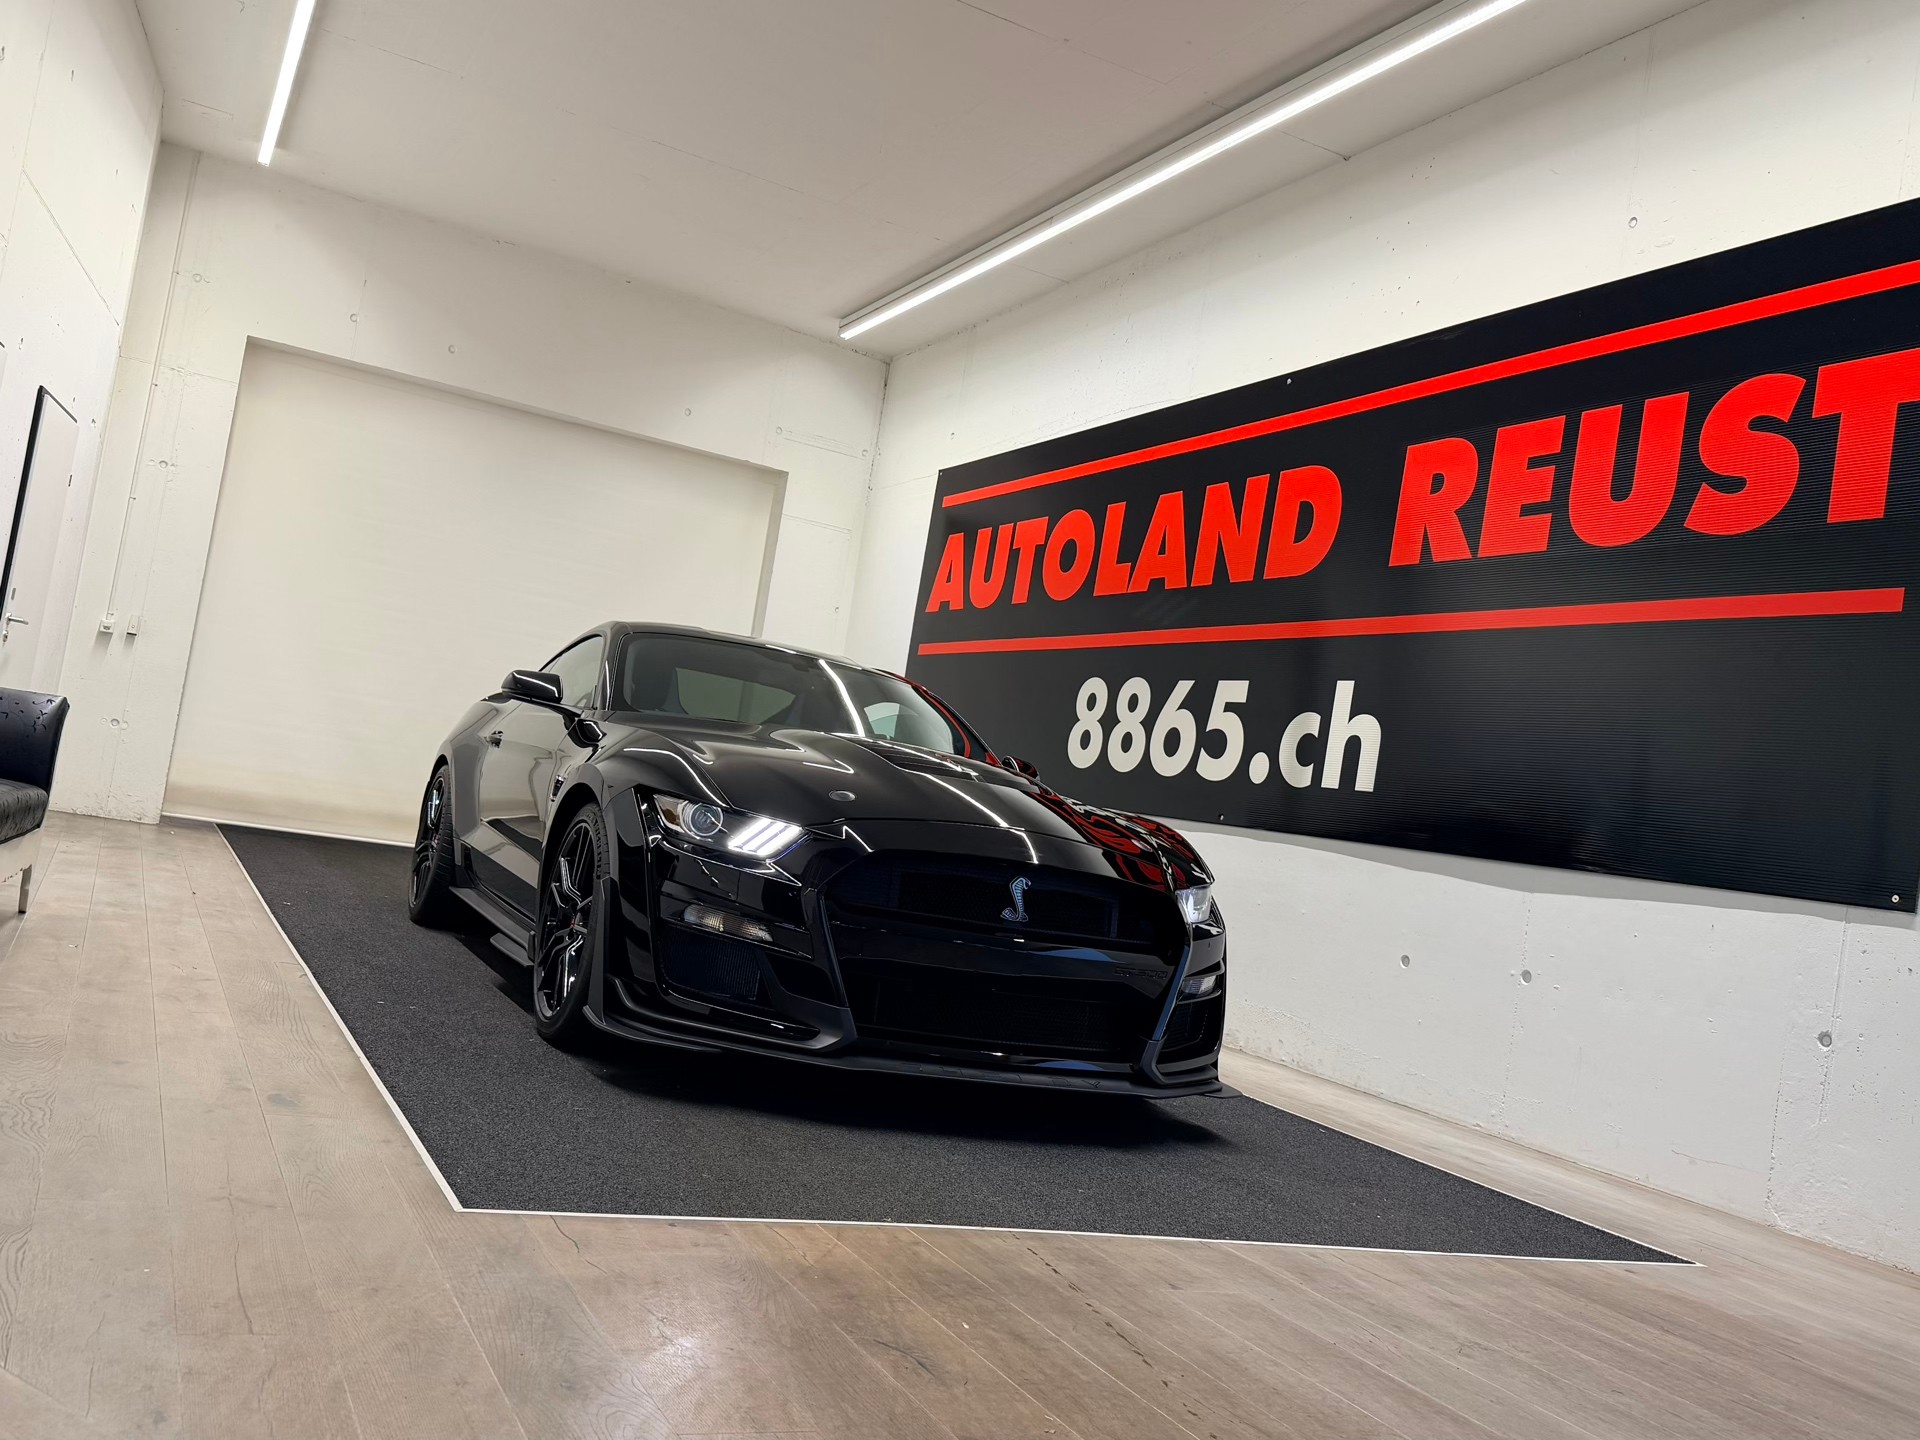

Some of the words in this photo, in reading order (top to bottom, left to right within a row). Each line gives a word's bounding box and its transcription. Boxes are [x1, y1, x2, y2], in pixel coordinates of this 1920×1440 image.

[926, 466, 1342, 612] AUTOLAND
[1389, 348, 1920, 566] REUST
[1068, 677, 1381, 792] 8865.ch
